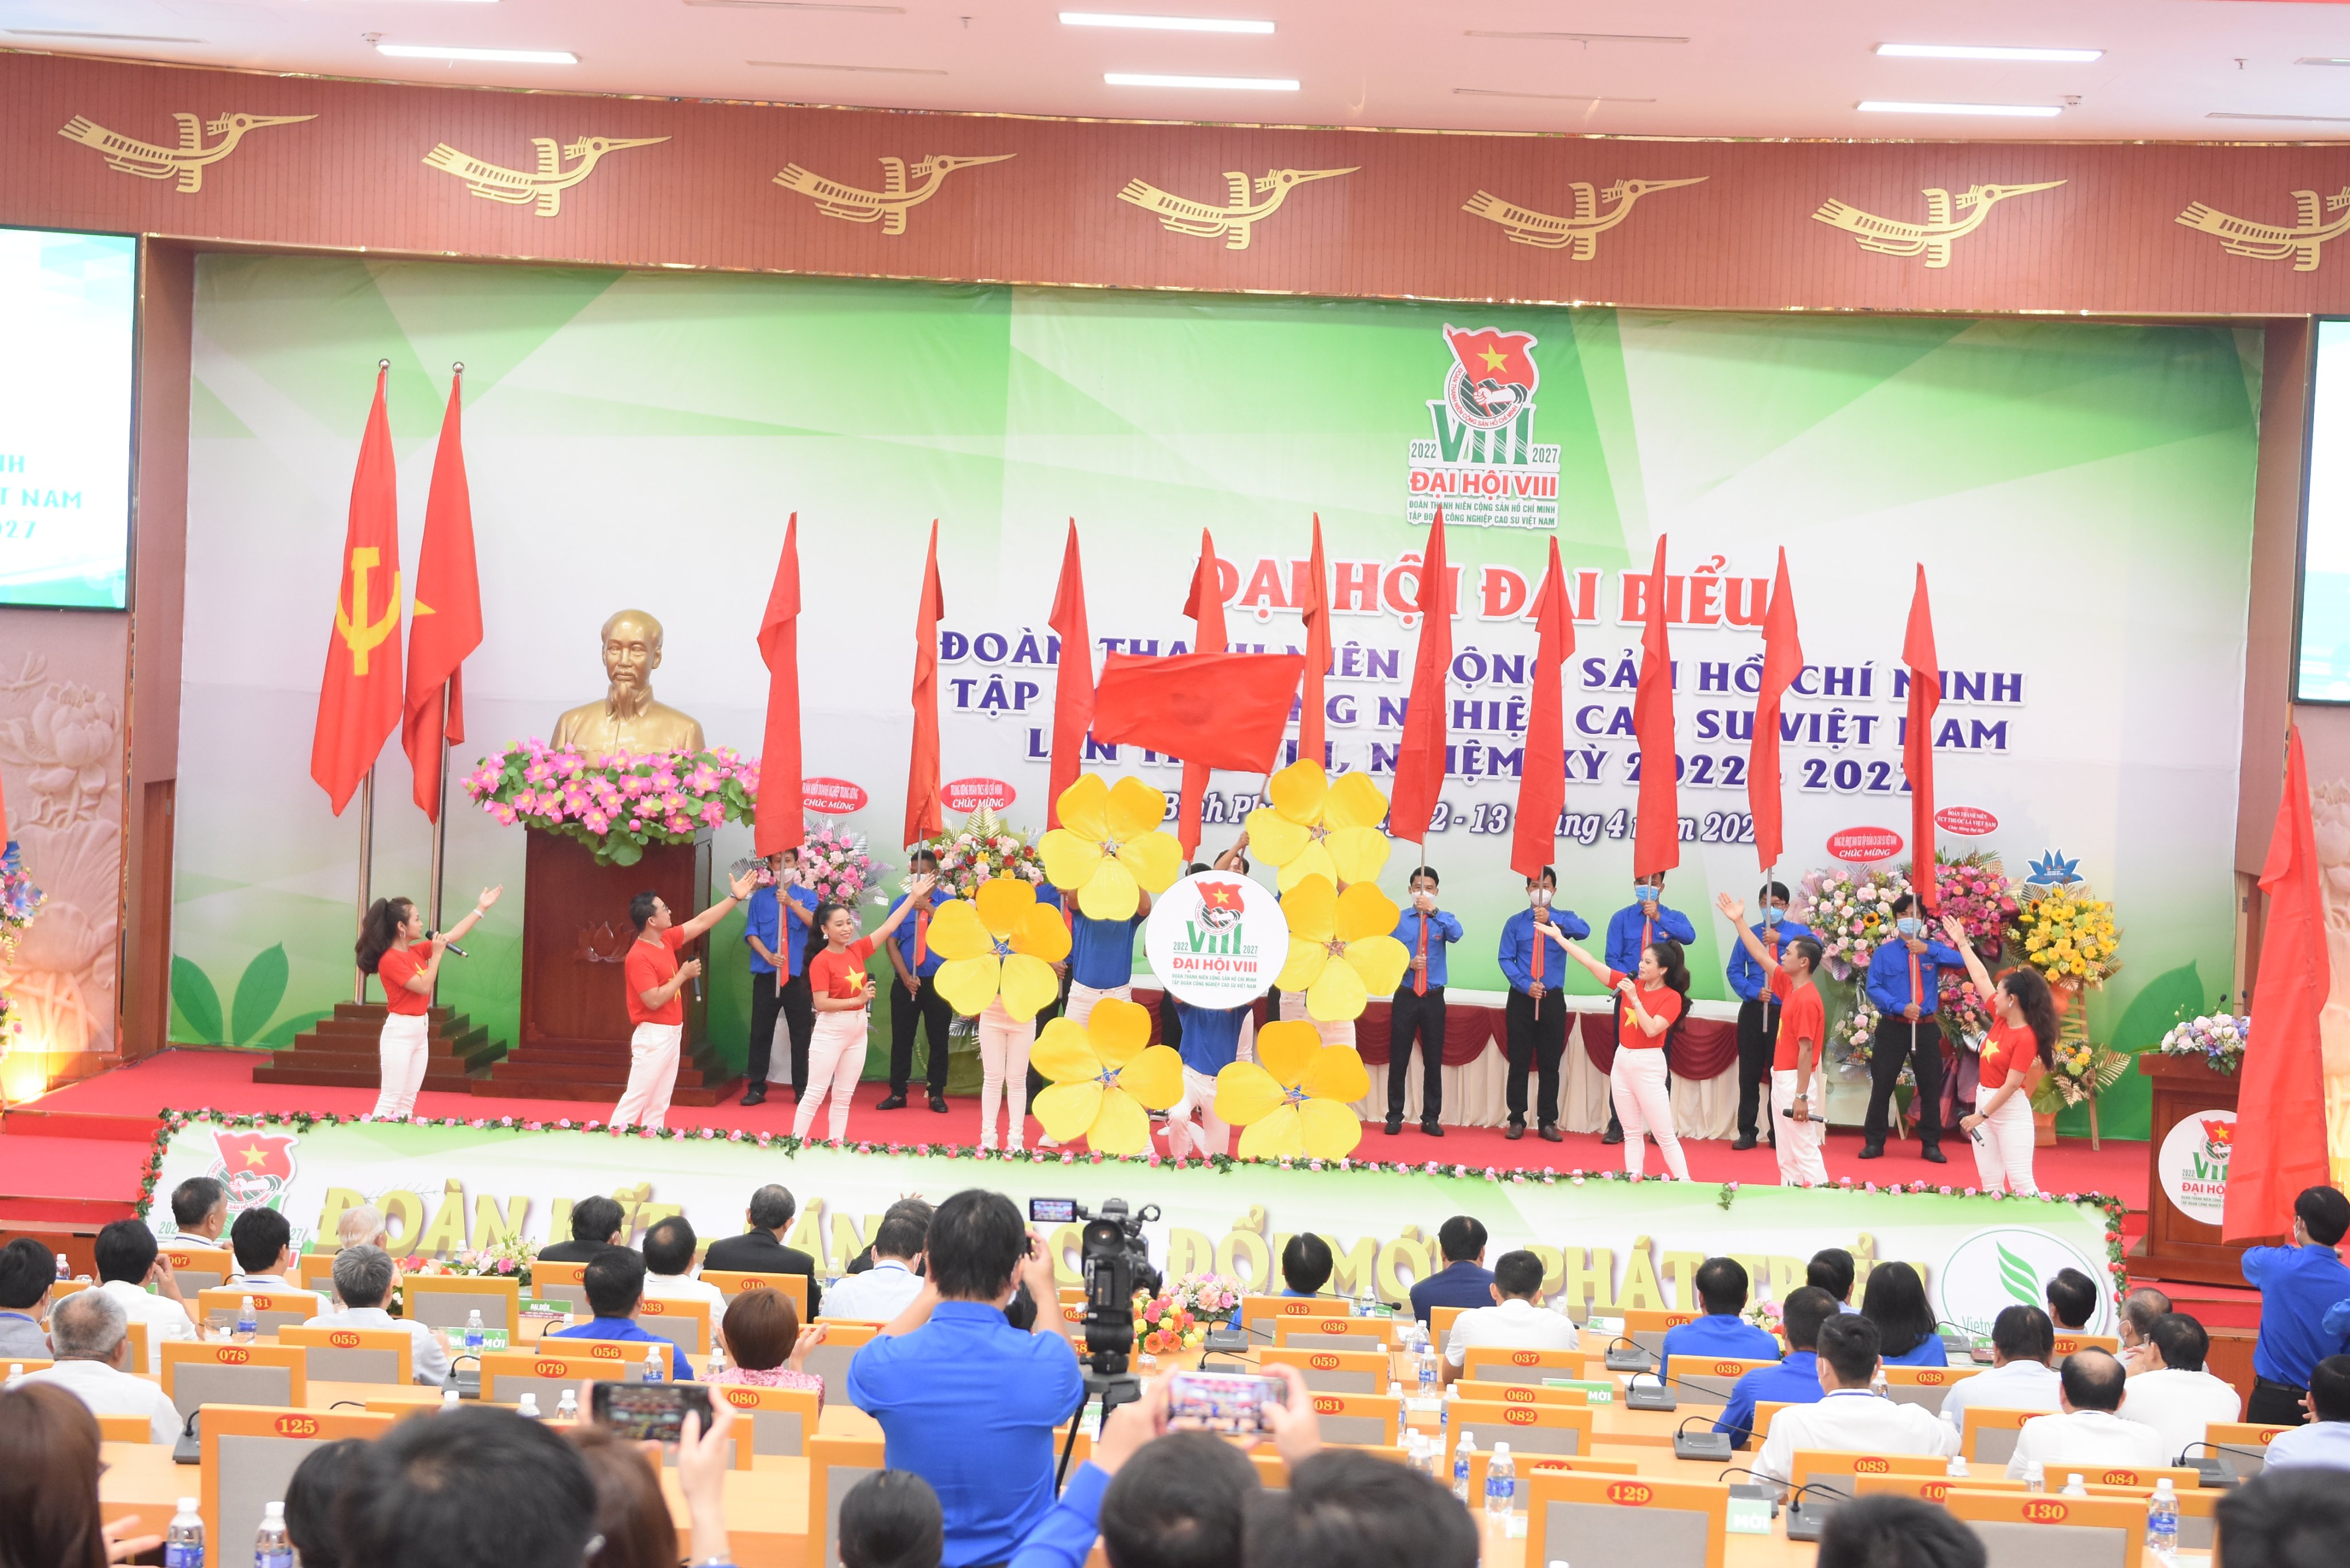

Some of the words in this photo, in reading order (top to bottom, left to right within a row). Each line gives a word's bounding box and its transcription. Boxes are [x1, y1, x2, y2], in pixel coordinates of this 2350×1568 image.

[1411, 443, 1436, 458] 2022
[1532, 448, 1558, 463] 2027
[1410, 471, 1455, 498] ĐẠI
[1463, 470, 1508, 500] HỘI
[1515, 476, 1556, 496] VIII
[22, 488, 81, 509] NAM
[1409, 500, 1429, 508] ĐOÀN
[1455, 501, 1472, 511] NIÊN
[1473, 502, 1492, 513] CỘNG
[1495, 502, 1509, 512] SẢN
[1523, 504, 1535, 513] CHÍ
[1537, 505, 1555, 513] MINH
[1409, 512, 1421, 522] TẬP
[1445, 513, 1464, 522] CÔNG
[1466, 514, 1492, 524] NGHIỆP
[1495, 515, 1508, 524] CAO
[1510, 516, 1519, 524] SU
[1522, 515, 1536, 527] VIỆT
[1539, 517, 1555, 526] NAM
[1333, 554, 1462, 624] HỘI
[1621, 555, 1770, 625] BIỂU
[1445, 646, 1537, 689] ỘN
[1582, 648, 1679, 690] SẢ
[1699, 653, 1764, 692] HỒ
[1791, 661, 1875, 697] CHÍ
[950, 674, 1039, 716] TẬP
[1575, 705, 1675, 735] CA
[1697, 709, 1755, 740] SU
[1780, 707, 1879, 749] VIỆT
[1371, 739, 1525, 781] NIỆM
[804, 798, 827, 807] CHÚC
[828, 800, 855, 810] MỪNG
[952, 797, 976, 808] CHÚC
[978, 796, 1004, 807] MỪNG
[1471, 804, 1508, 833] 13
[1606, 810, 1625, 838] 4
[1702, 813, 1756, 843] 202
[1839, 848, 1862, 857] CHÚC
[1864, 847, 1890, 856] MỪNG
[1173, 941, 1188, 950] 2022
[1243, 945, 1258, 954] 2027
[1173, 958, 1199, 972] ĐẠI
[1203, 957, 1230, 974] HỘI
[1233, 960, 1257, 972] VIII
[2182, 1169, 2195, 1177] 2022
[2182, 1182, 2203, 1195] ĐẠI
[2207, 1183, 2225, 1197] HỘ
[158, 1221, 178, 1234] 202
[743, 1281, 764, 1290] 010
[1287, 1305, 1308, 1314] 013
[1323, 1321, 1345, 1332] 036
[1667, 1317, 1688, 1326] 015
[332, 1334, 357, 1345] 055
[594, 1347, 619, 1357] 056
[2054, 1341, 2075, 1351] 017
[219, 1349, 247, 1361] 078
[1514, 1353, 1538, 1363] 037
[1312, 1356, 1337, 1367] 059
[537, 1362, 565, 1375] 079
[1717, 1364, 1740, 1374] 039
[1919, 1373, 1942, 1383] 038
[730, 1393, 757, 1405] 080
[1507, 1391, 1532, 1402] 060
[1588, 1390, 1611, 1401] MỜI
[1314, 1399, 1340, 1411] 081
[1507, 1411, 1534, 1423] 082
[280, 1418, 315, 1434] 125
[1857, 1460, 1886, 1473] 083
[2106, 1473, 2134, 1485] 084
[1613, 1485, 1649, 1501] 129
[1924, 1485, 1945, 1497] 10
[2026, 1503, 2065, 1519] 130
[1733, 1512, 1768, 1530] MỜI
